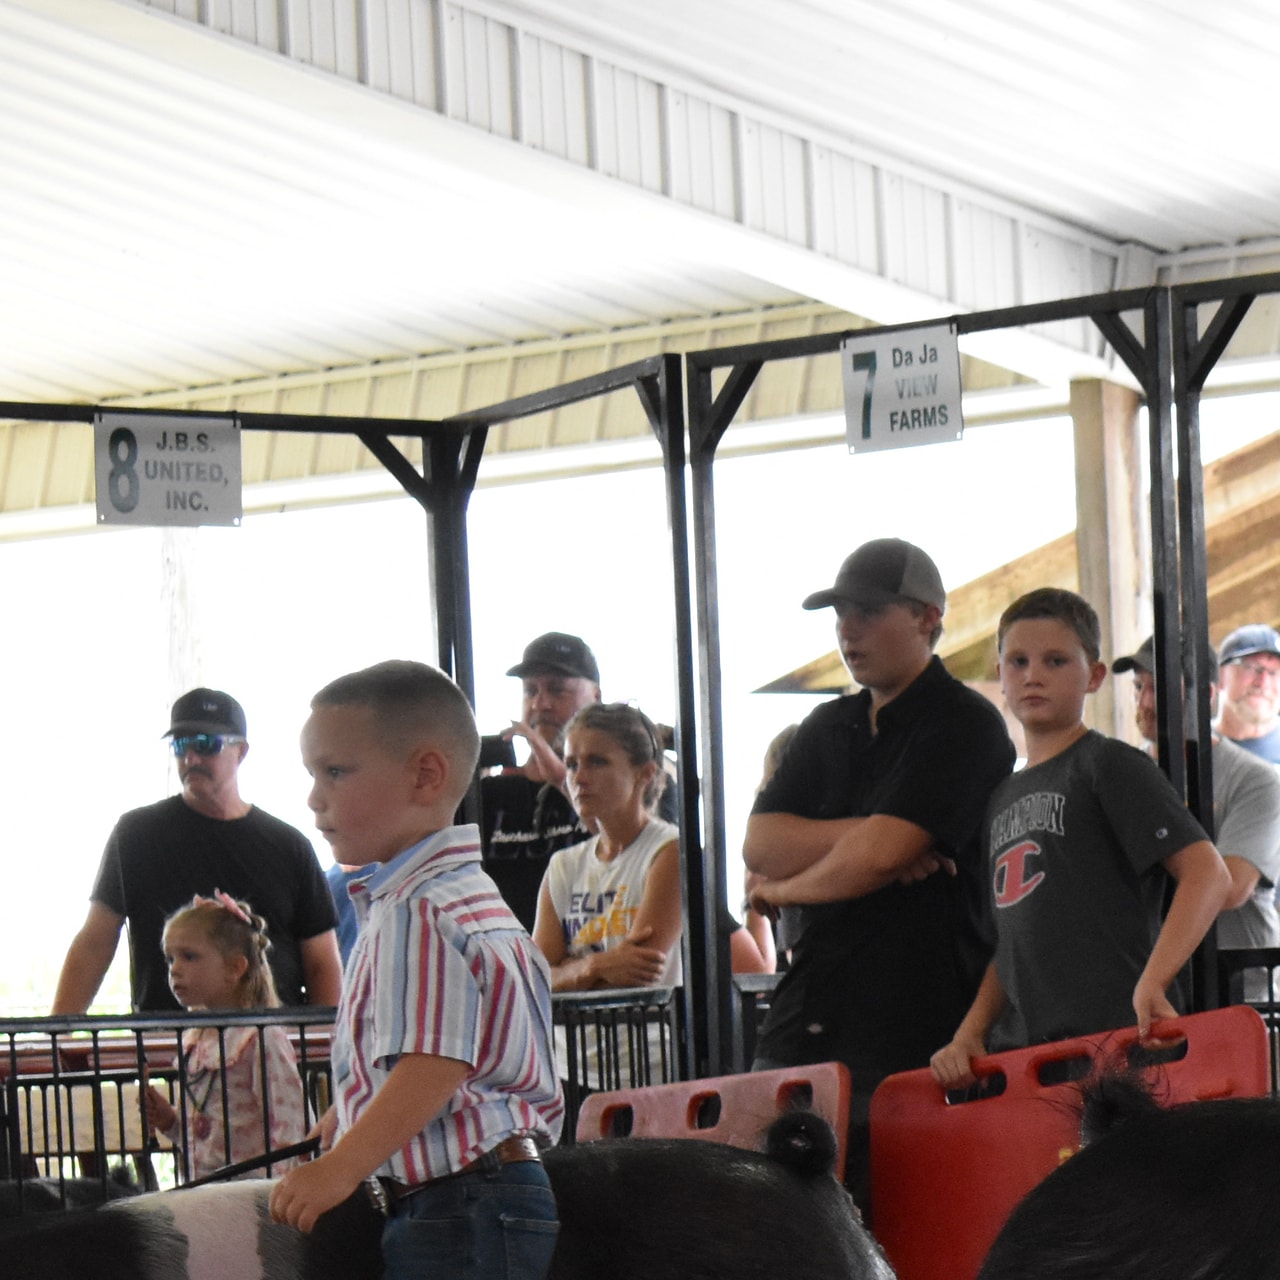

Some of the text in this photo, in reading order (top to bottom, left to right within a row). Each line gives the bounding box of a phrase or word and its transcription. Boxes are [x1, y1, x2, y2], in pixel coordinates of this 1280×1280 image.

[892, 344, 938, 368] Da Ja
[852, 350, 877, 440] 7
[895, 374, 938, 399] VIEW
[890, 404, 949, 432] FARMS
[156, 431, 216, 452] J.B.S.
[108, 427, 139, 513] 8
[145, 460, 228, 486] UNITED,
[166, 491, 209, 511] INC.
